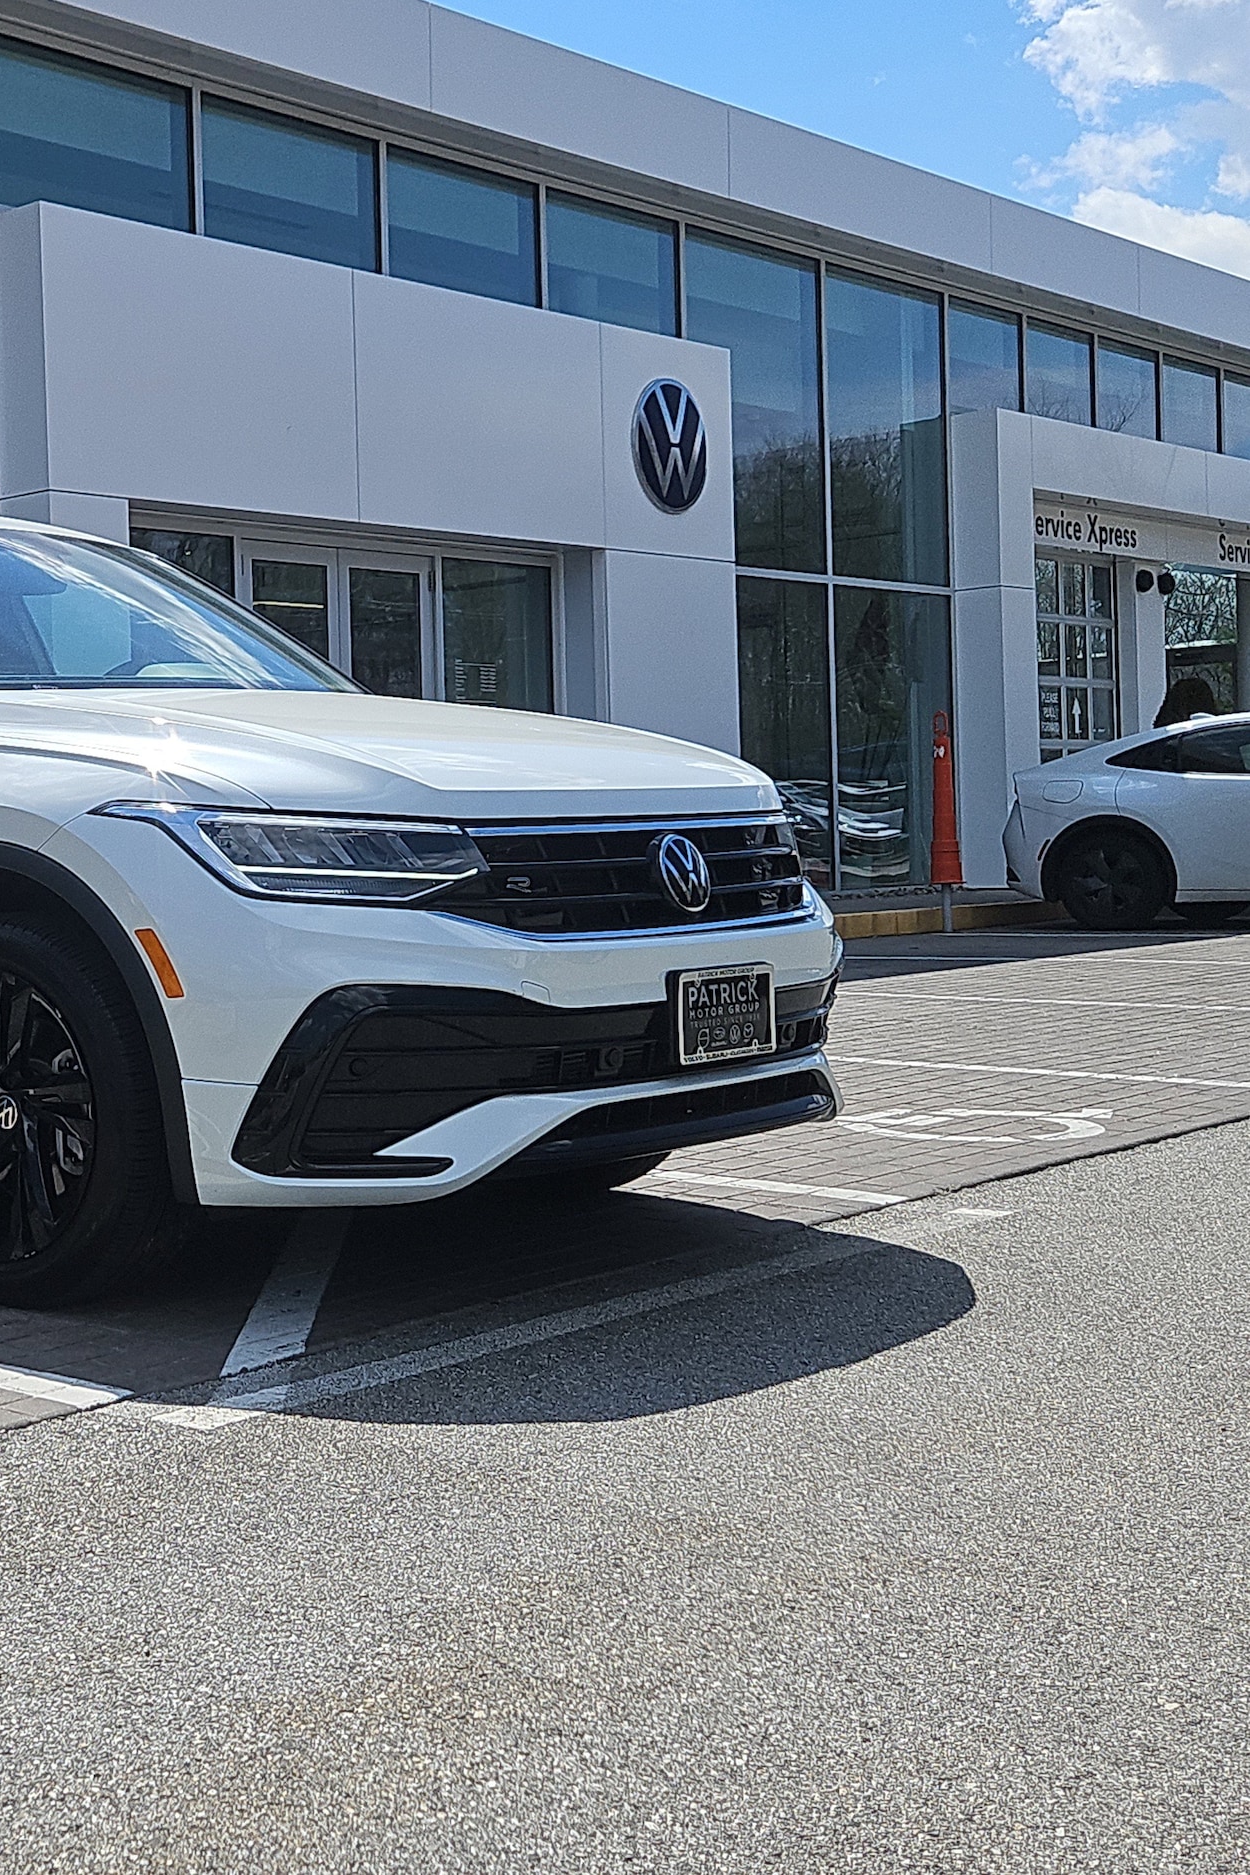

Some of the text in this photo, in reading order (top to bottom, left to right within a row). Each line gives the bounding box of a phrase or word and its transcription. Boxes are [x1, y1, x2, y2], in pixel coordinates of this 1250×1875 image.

[1087, 513, 1137, 551] Xpress
[1219, 533, 1250, 564] Servi
[688, 980, 759, 1008] PATRICK
[689, 1001, 760, 1019] MOTOR GROUP
[690, 1018, 721, 1028] TRUSTED
